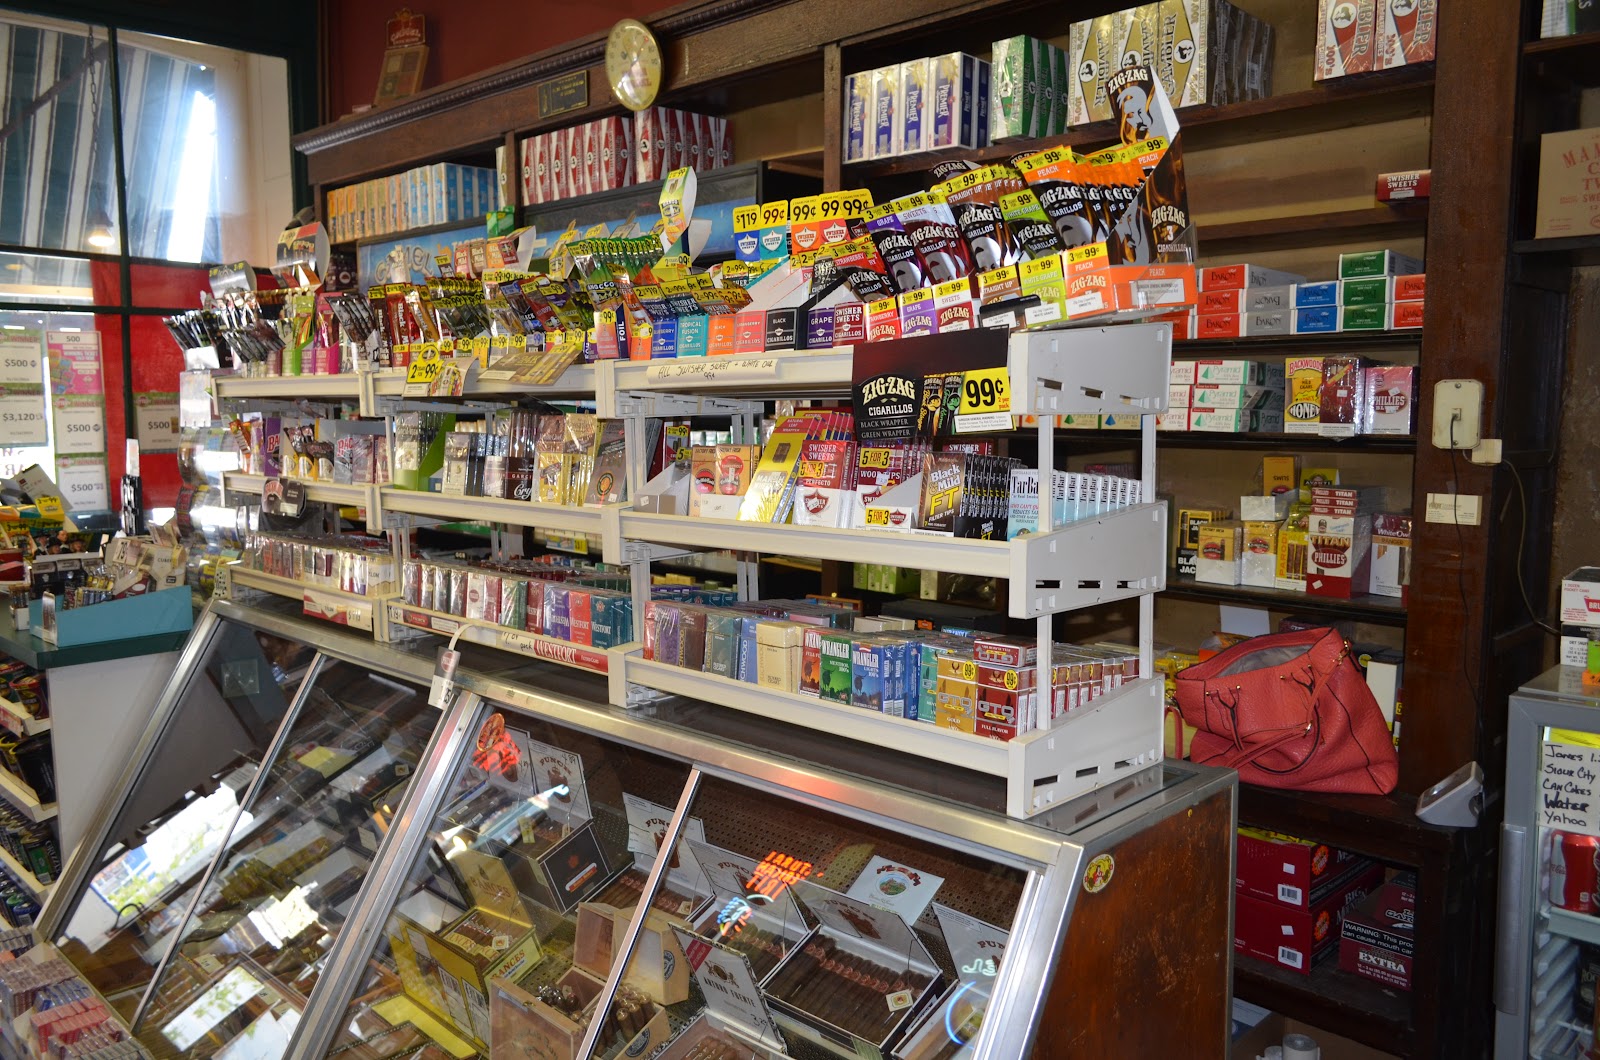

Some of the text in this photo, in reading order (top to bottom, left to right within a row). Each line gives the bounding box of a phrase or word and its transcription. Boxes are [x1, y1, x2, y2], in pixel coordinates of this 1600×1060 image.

[1108, 68, 1149, 95] ZIG-ZAG
[908, 90, 919, 124] PREMIER
[938, 84, 950, 118] PREMIER
[852, 101, 862, 133] PREMIER
[880, 96, 890, 128] PREMIER
[1146, 139, 1163, 151] 99¢
[1024, 151, 1061, 170] 3 99¢
[1138, 153, 1158, 164] PEACH
[1037, 165, 1059, 177] PEACH
[946, 173, 979, 193] 3 99¢
[1387, 173, 1420, 184] SWISHER
[1387, 179, 1418, 189] SWEETS
[948, 186, 982, 203] STRAIGHT UP
[1040, 186, 1080, 209] ZIG-ZAG
[843, 199, 869, 216] 99¢
[895, 201, 903, 212] 3
[1002, 194, 1033, 210] 3 99¢
[763, 208, 785, 225] 99¢
[793, 204, 817, 221] 99¢
[866, 210, 874, 220] 3
[902, 207, 927, 219] SWEETS
[1151, 206, 1186, 229] ZIG-ZAG
[877, 216, 894, 227] GRAPE
[959, 207, 994, 232] ZIG-ZAG
[764, 236, 780, 244] SWISHER
[910, 225, 944, 247] ZIG-ZAG
[1166, 226, 1174, 241] 3
[835, 253, 864, 265] STRAWBERRY
[1084, 247, 1100, 258] 99¢
[1040, 259, 1054, 270] 99¢
[1075, 261, 1094, 272] PEACH
[996, 270, 1010, 280] 99¢
[1023, 271, 1058, 285] WHITE GRAPE
[1149, 268, 1166, 276] PEACH
[1211, 271, 1236, 281] BARON
[952, 282, 964, 292] 99¢
[1004, 281, 1013, 289] UP
[1070, 275, 1106, 294] ZIG-ZAG
[694, 292, 701, 300] 2
[942, 295, 961, 305] SWEETS
[1206, 295, 1230, 306] BARON
[398, 302, 406, 328] Black
[836, 307, 862, 316] SWISHER
[906, 304, 921, 313] GRAPE
[811, 317, 832, 325] GRAPE
[836, 314, 860, 323] SWEETS
[940, 306, 970, 325] ZIG-ZAG
[904, 316, 933, 333] ZIG-ZAG
[1206, 318, 1231, 329] BARON
[835, 330, 861, 338] CIGARILLOS
[4, 358, 28, 368] $500
[410, 364, 438, 378] 2 99¢
[658, 366, 670, 379] ALL
[1212, 366, 1241, 376] Pyramid
[862, 376, 916, 406] ZIG-ZAG
[965, 377, 1004, 408] 99¢
[1209, 390, 1237, 400] Pyramid
[868, 403, 914, 417] CIGARILLOS
[1289, 402, 1320, 419] HONEY
[2, 413, 36, 422] $3,120
[860, 418, 909, 429] BLACK WRAPPER
[1206, 414, 1233, 424] Pyramid
[67, 424, 92, 433] $500
[148, 421, 170, 430] $500
[862, 429, 911, 439] GREEN WRAPPER
[808, 444, 837, 453] SWISHER
[809, 452, 835, 461] SWEETS
[862, 450, 890, 466] 5 FOR 3
[800, 462, 824, 477] 5 3
[931, 464, 960, 482] Black
[71, 483, 94, 492] $500
[938, 475, 961, 492] Mild
[930, 486, 960, 516] FT
[868, 510, 890, 525] 5 FOR 3
[928, 512, 944, 523] FILTER
[1311, 536, 1352, 548] TITAN
[1280, 532, 1288, 577] PARODI
[1314, 552, 1346, 565] PHILLIES
[570, 619, 590, 630] WESTFORT
[592, 621, 612, 635] WESTFORT
[536, 640, 577, 664] WESTFORT
[822, 640, 850, 659] WRANGLER
[830, 660, 849, 668] MENTHOL
[852, 650, 878, 668] WRANGLER
[938, 692, 973, 713] GTO
[978, 700, 1015, 722] GTO
[946, 716, 960, 724] GOLD
[992, 726, 1009, 735] FLAVOR
[540, 756, 573, 777] PUNCH
[1576, 767, 1596, 784] City
[1344, 922, 1397, 944] WARNING: This
[1356, 934, 1376, 944] cause
[1377, 940, 1400, 951] mouth
[1358, 952, 1406, 974] EXTRA
